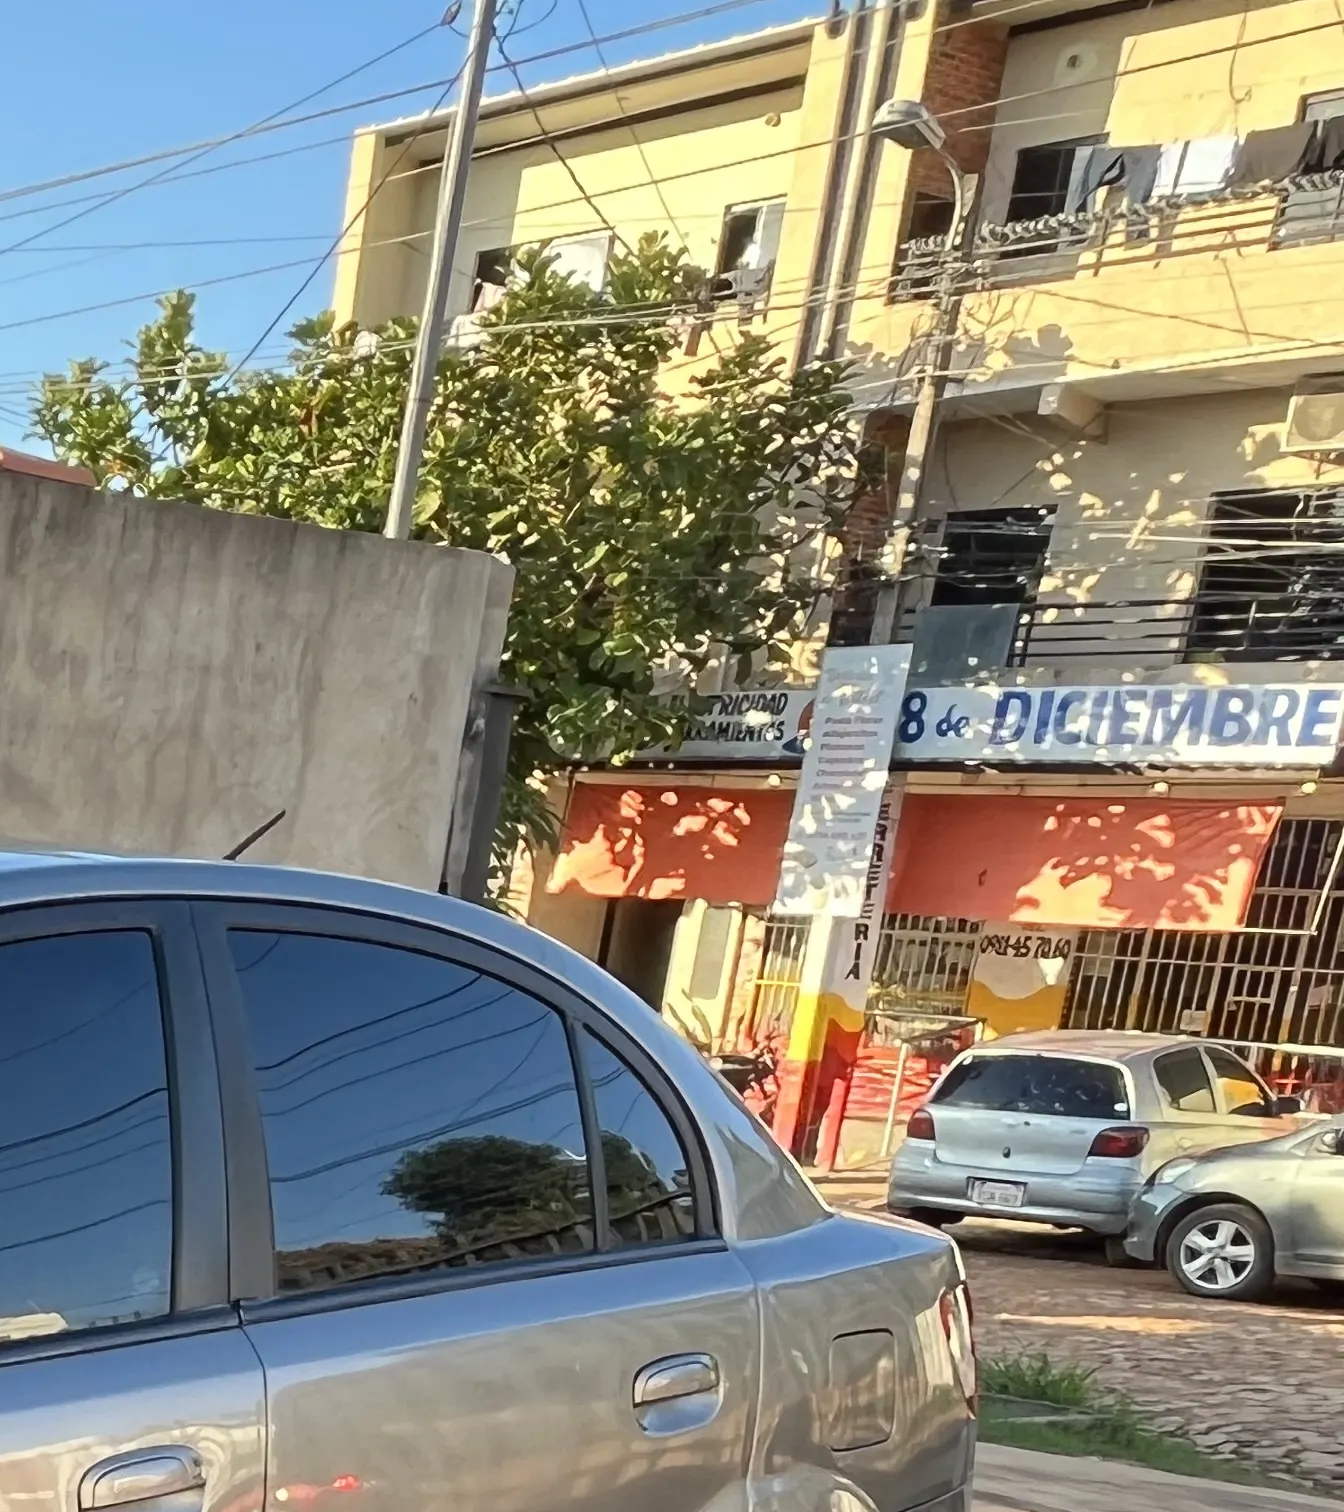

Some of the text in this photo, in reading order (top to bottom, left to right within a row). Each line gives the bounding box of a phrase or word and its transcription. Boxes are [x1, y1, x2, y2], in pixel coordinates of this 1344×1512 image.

[898, 688, 1343, 747] 8 de DICIEMBRE
